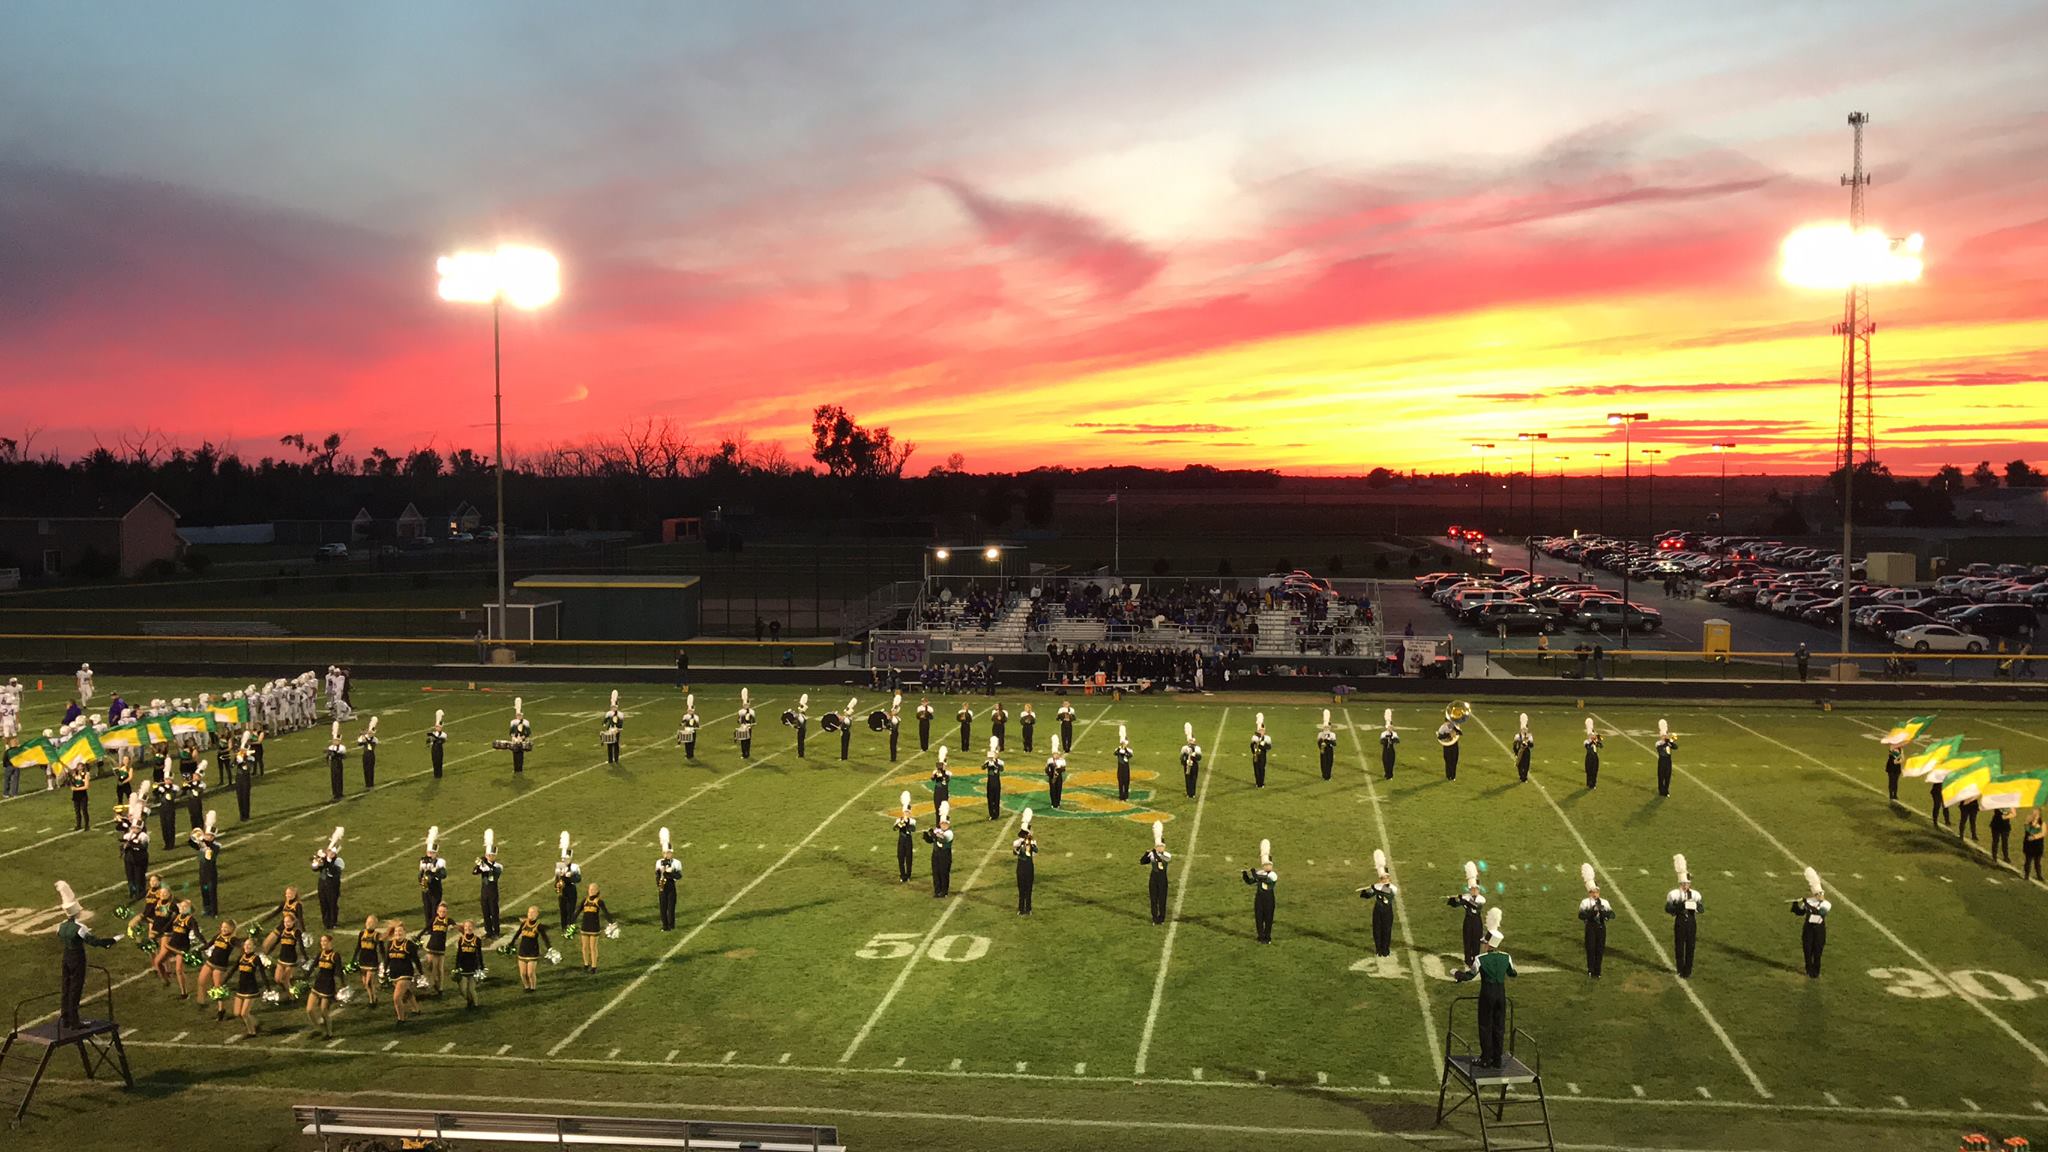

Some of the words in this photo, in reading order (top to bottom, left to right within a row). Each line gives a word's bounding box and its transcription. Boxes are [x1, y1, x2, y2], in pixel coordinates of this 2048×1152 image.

[878, 647, 926, 663] BEAST
[3, 708, 14, 716] 24
[855, 933, 992, 962] 50
[1866, 967, 2037, 1000] 30
